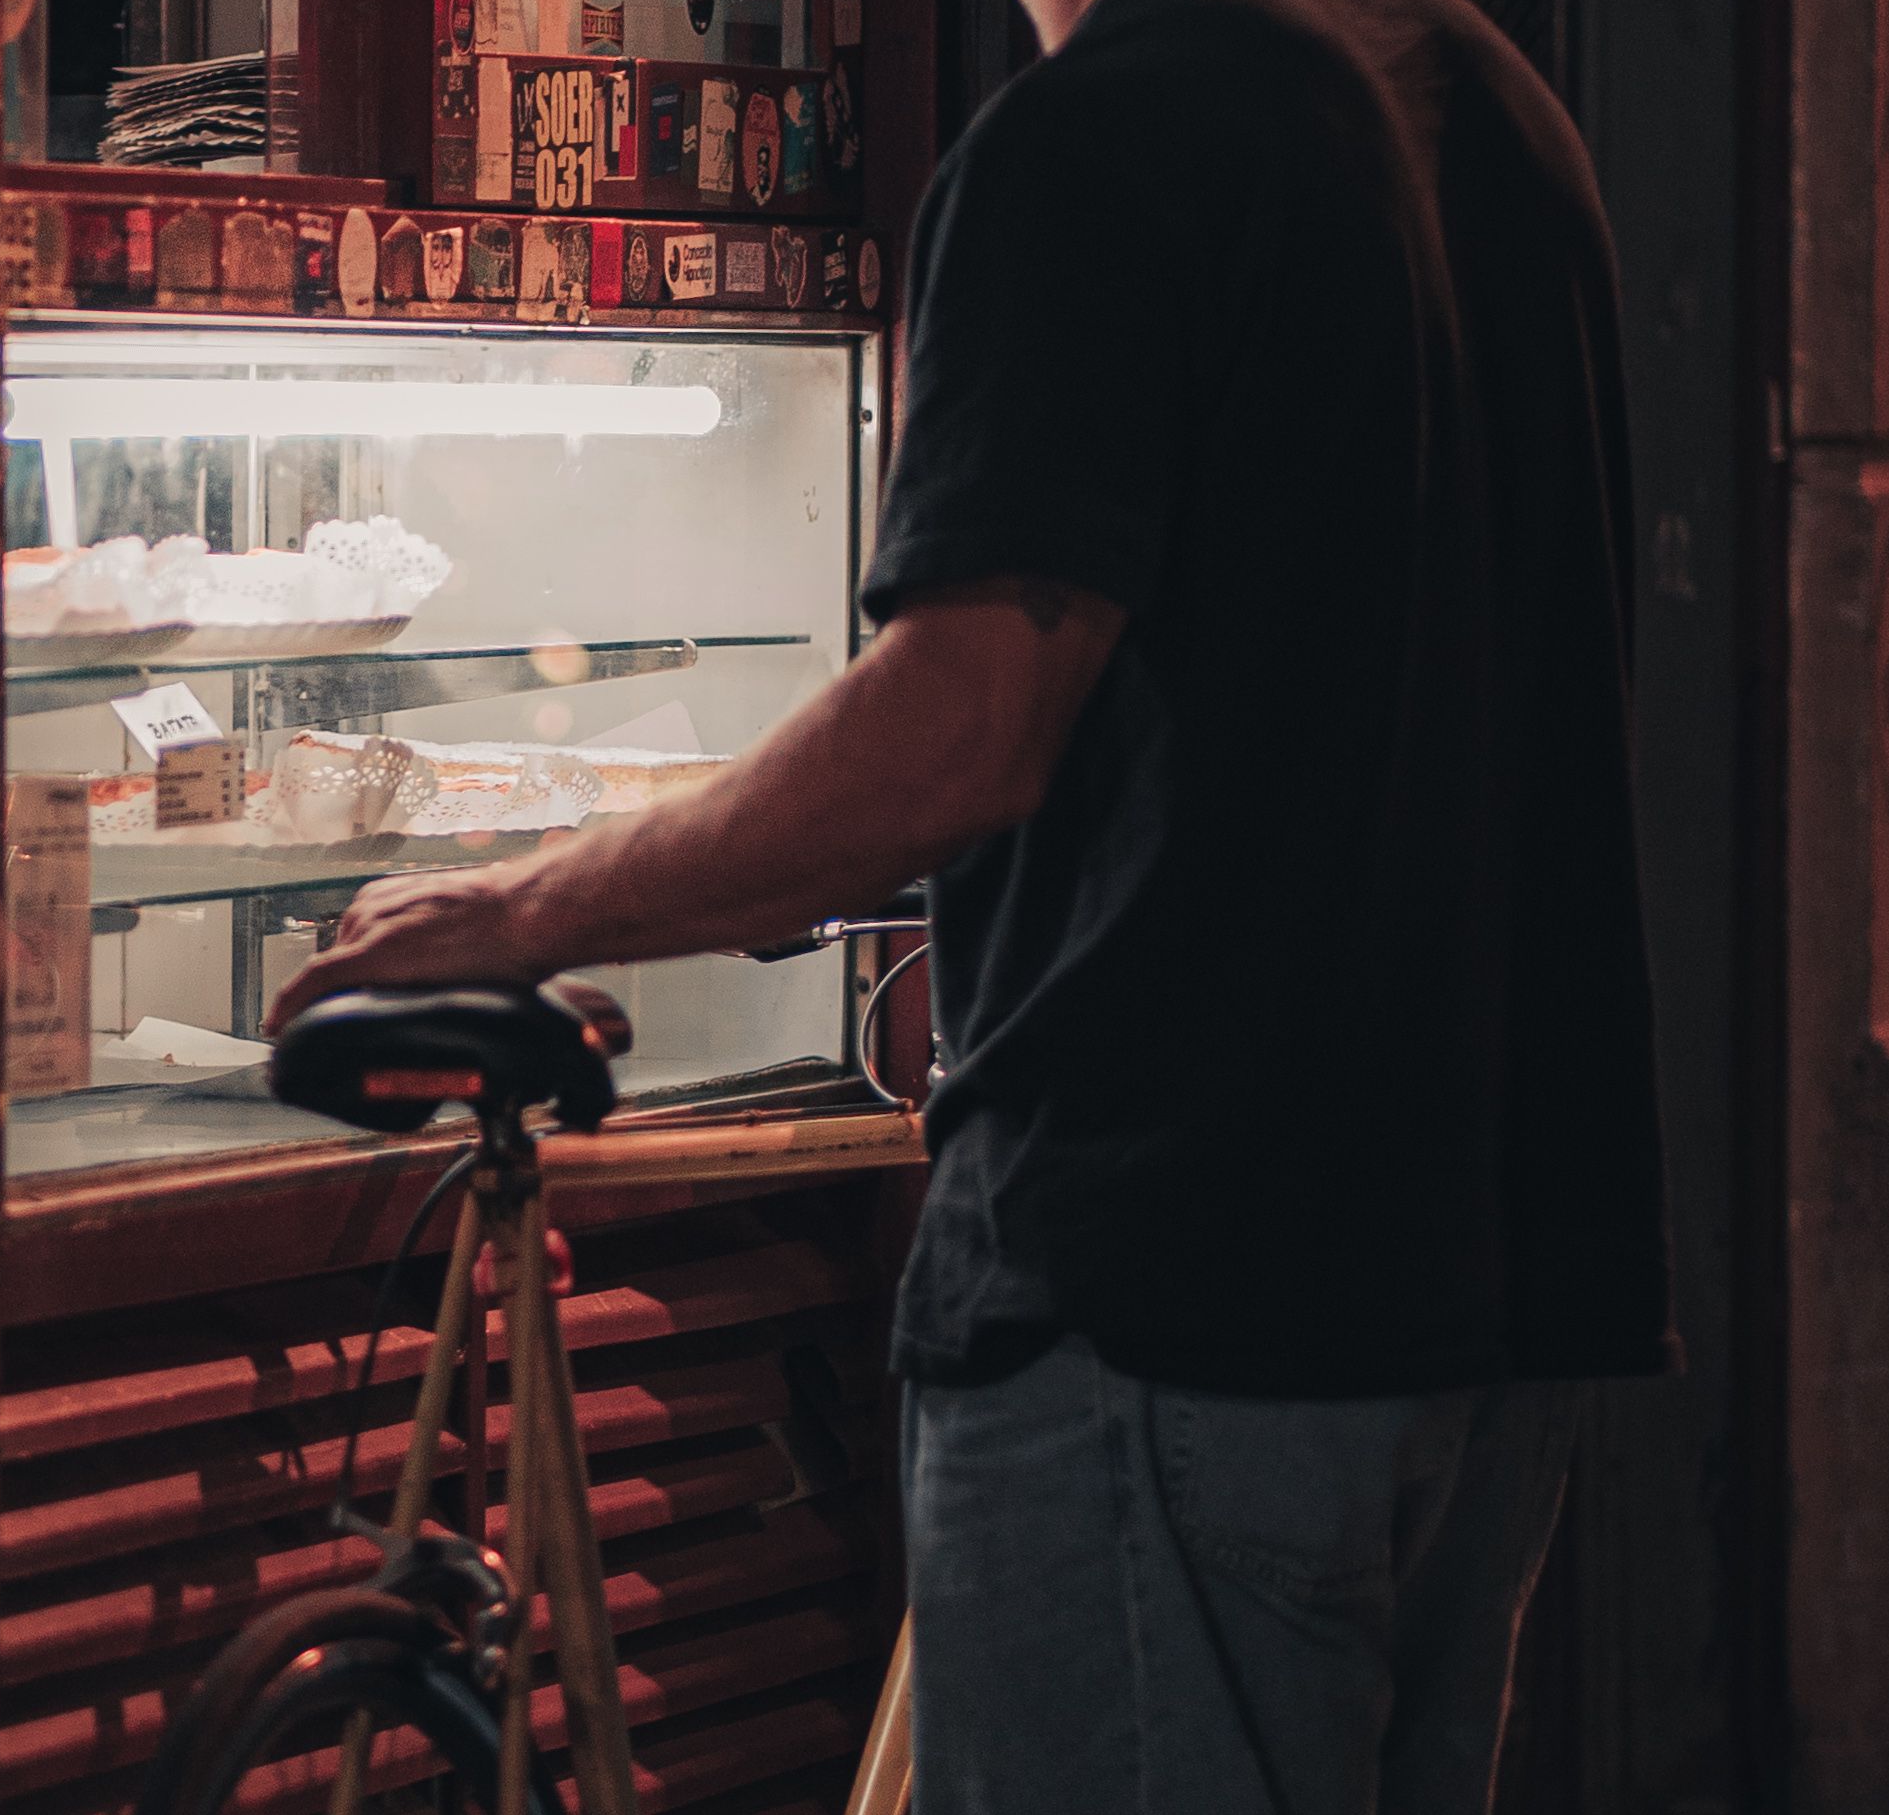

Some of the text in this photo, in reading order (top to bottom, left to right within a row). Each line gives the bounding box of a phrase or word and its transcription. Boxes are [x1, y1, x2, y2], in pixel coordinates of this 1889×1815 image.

[583, 13, 624, 36] SPIRITS
[535, 70, 594, 147] SOER
[535, 147, 593, 210] 031
